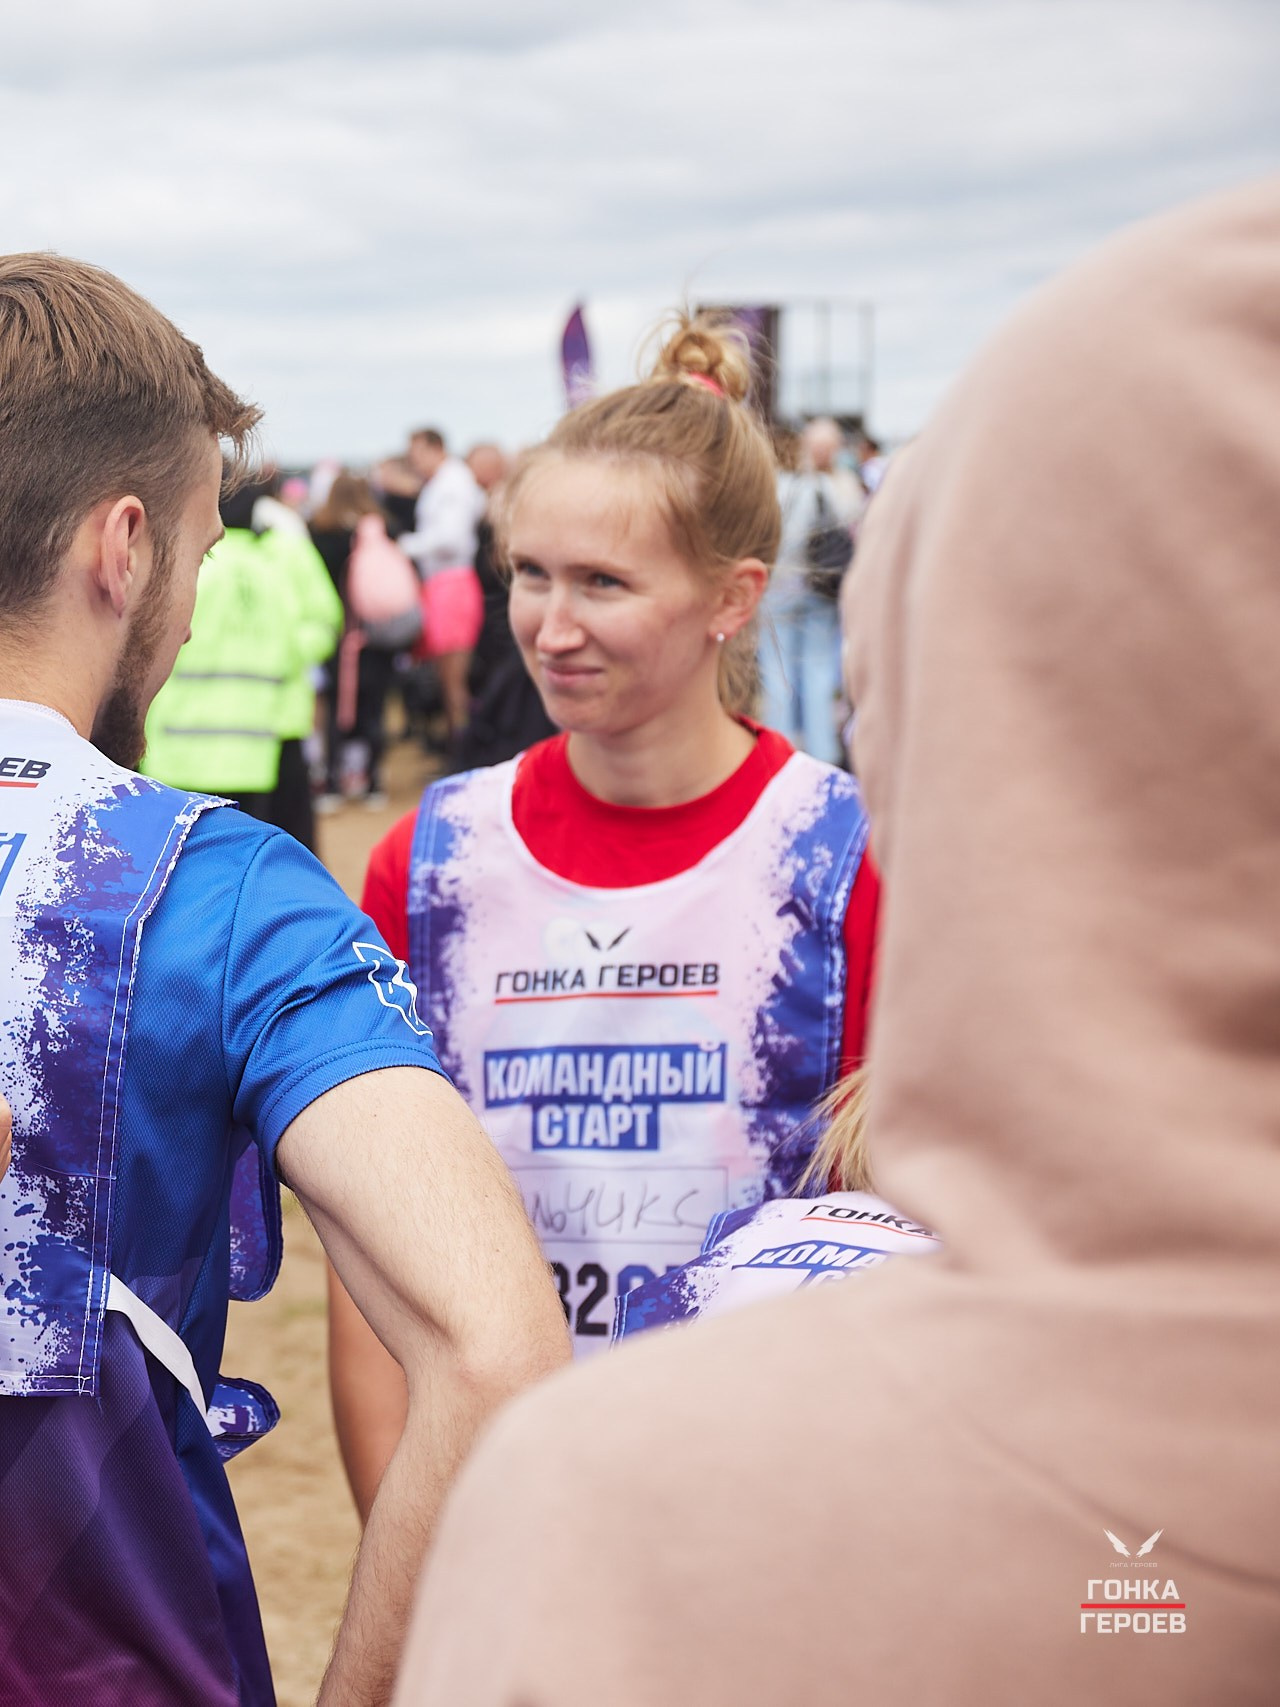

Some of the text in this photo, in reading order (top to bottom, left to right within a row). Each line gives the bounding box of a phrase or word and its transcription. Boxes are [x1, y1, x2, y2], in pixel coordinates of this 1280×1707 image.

[495, 963, 720, 994] ГОНКА ГЕРОЕВ
[486, 1041, 722, 1104] КОМАНДНЫЙ
[535, 1104, 654, 1148] СТАРТ
